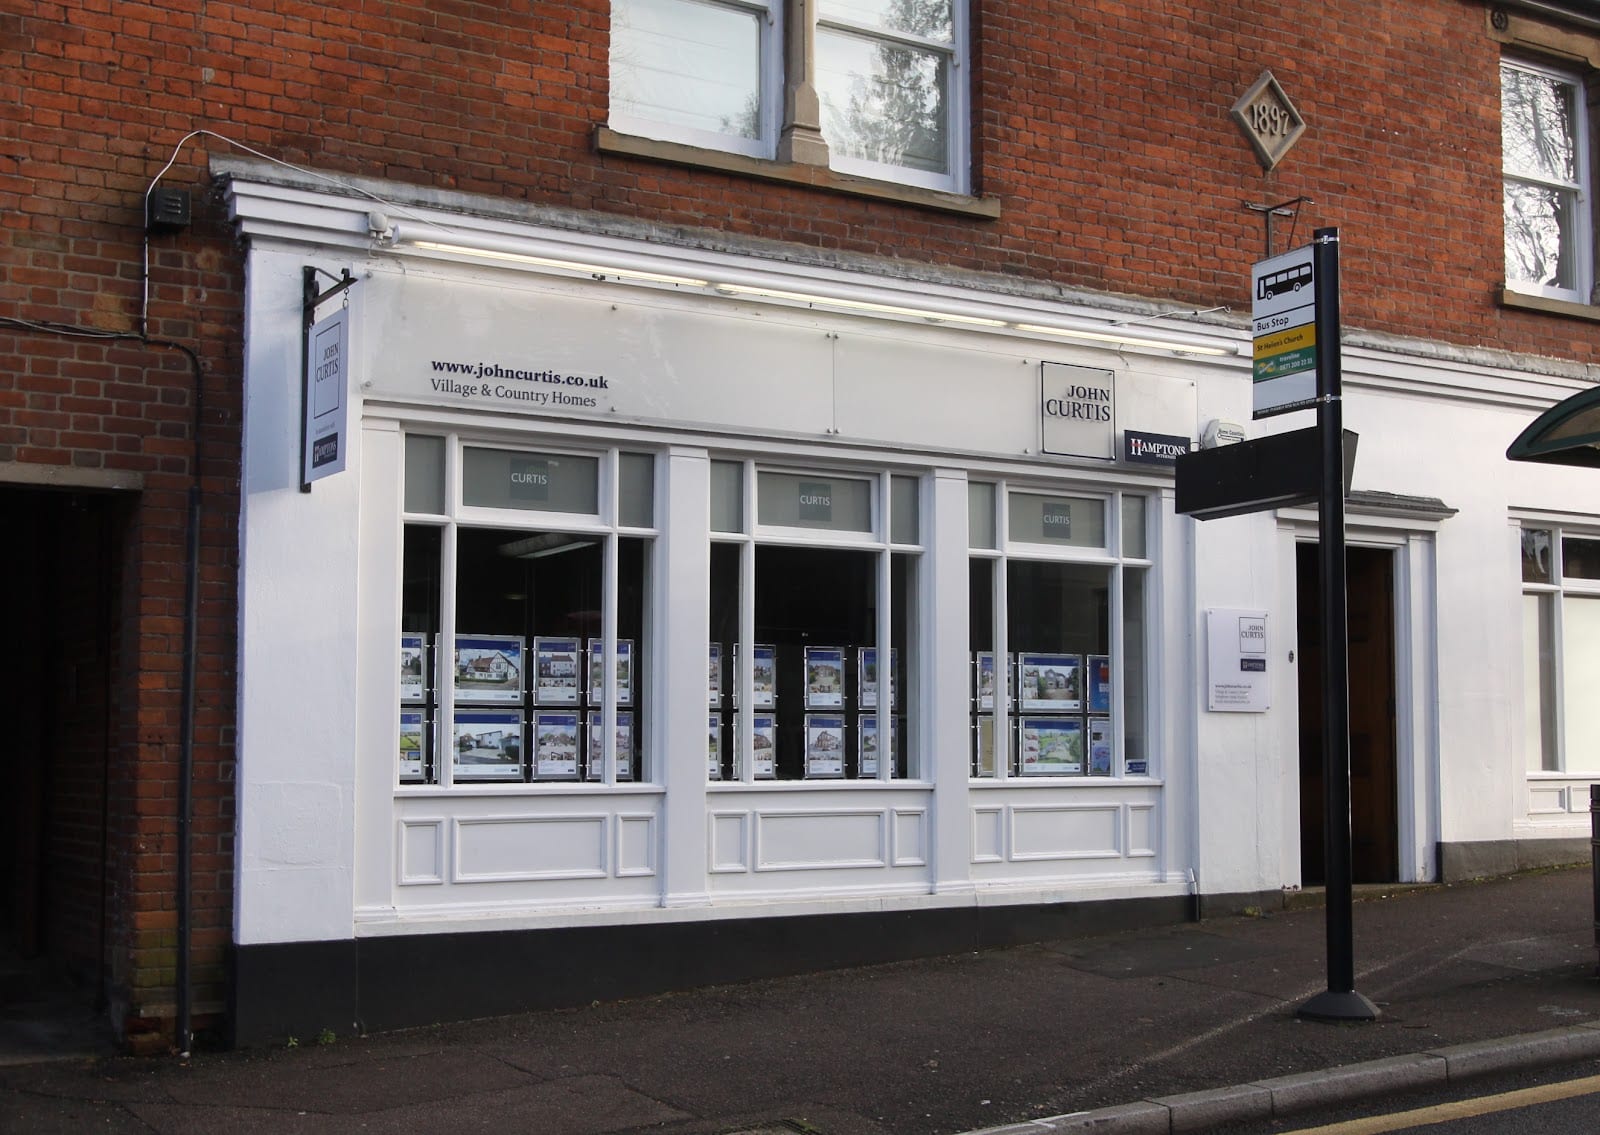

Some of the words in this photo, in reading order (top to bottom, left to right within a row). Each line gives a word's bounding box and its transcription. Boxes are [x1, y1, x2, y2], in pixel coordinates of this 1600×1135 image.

[1251, 103, 1289, 135] 1897
[1257, 322, 1270, 331] Bus
[1271, 317, 1289, 328] Stop
[1283, 334, 1304, 345] Church
[323, 342, 339, 361] JOHN
[1279, 352, 1300, 362] traveline
[315, 358, 339, 383] CURTIS
[431, 360, 609, 389] www.johncurtis.co.uk
[431, 378, 478, 398] Village
[481, 383, 492, 397] &
[495, 385, 550, 405] Country
[551, 391, 597, 407] Homes
[1067, 385, 1110, 402] JOHN
[1046, 398, 1111, 422] CURTIS
[1130, 438, 1187, 456] HAMPTONS
[511, 472, 548, 485] CURTIS
[800, 495, 830, 506] CURTIS
[1043, 514, 1070, 525] CURTIS
[1240, 631, 1264, 639] CURTIS
